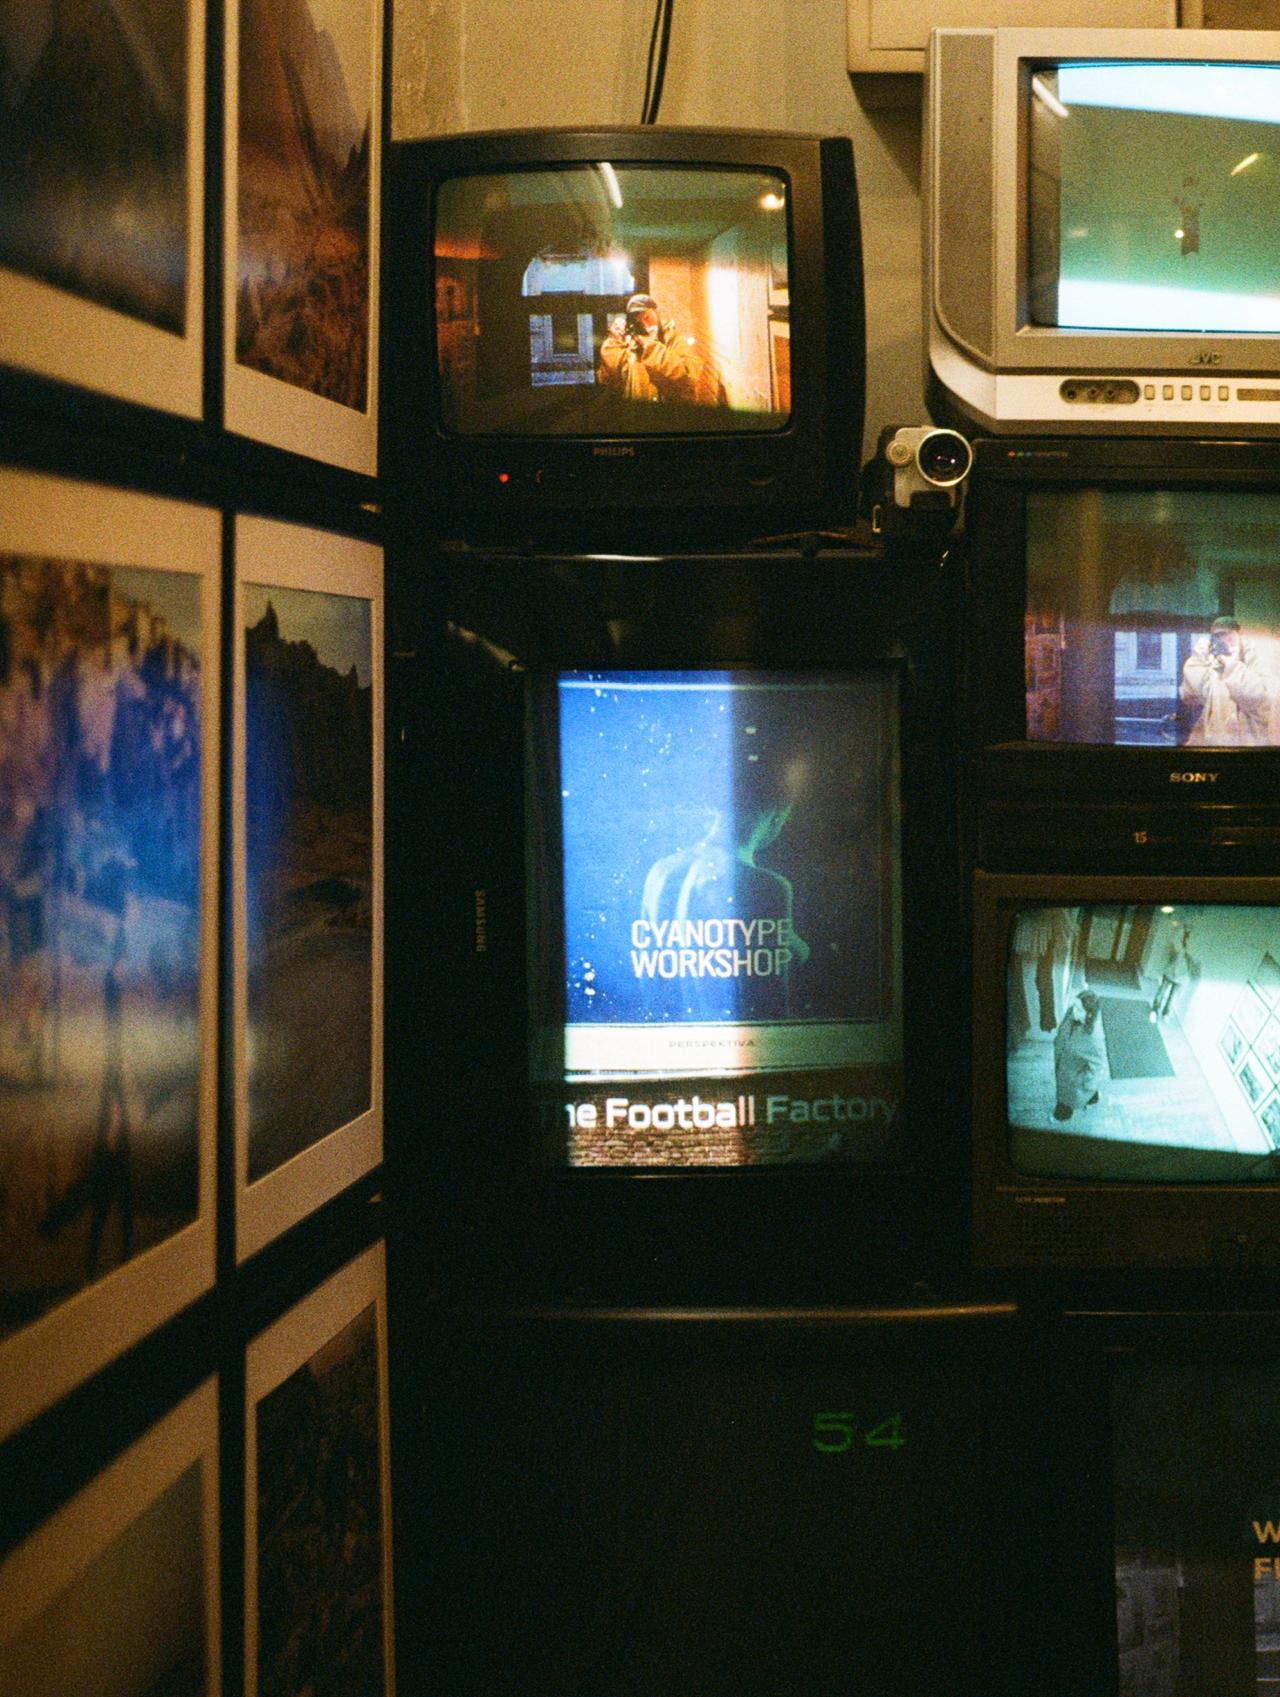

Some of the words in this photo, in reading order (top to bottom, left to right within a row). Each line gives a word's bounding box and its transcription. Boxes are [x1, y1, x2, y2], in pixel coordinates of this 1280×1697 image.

[1188, 350, 1223, 366] JVC
[592, 446, 636, 457] PHILIPS
[1168, 771, 1221, 784] SONY
[474, 887, 487, 953] SAMSUNG
[630, 918, 794, 949] CYANOTYPE
[630, 948, 793, 979] WORKSHOP
[668, 1039, 757, 1049] PERSPEKTIVA
[605, 1095, 755, 1129] Football
[766, 1094, 898, 1126] Factory
[812, 1410, 906, 1453] 54
